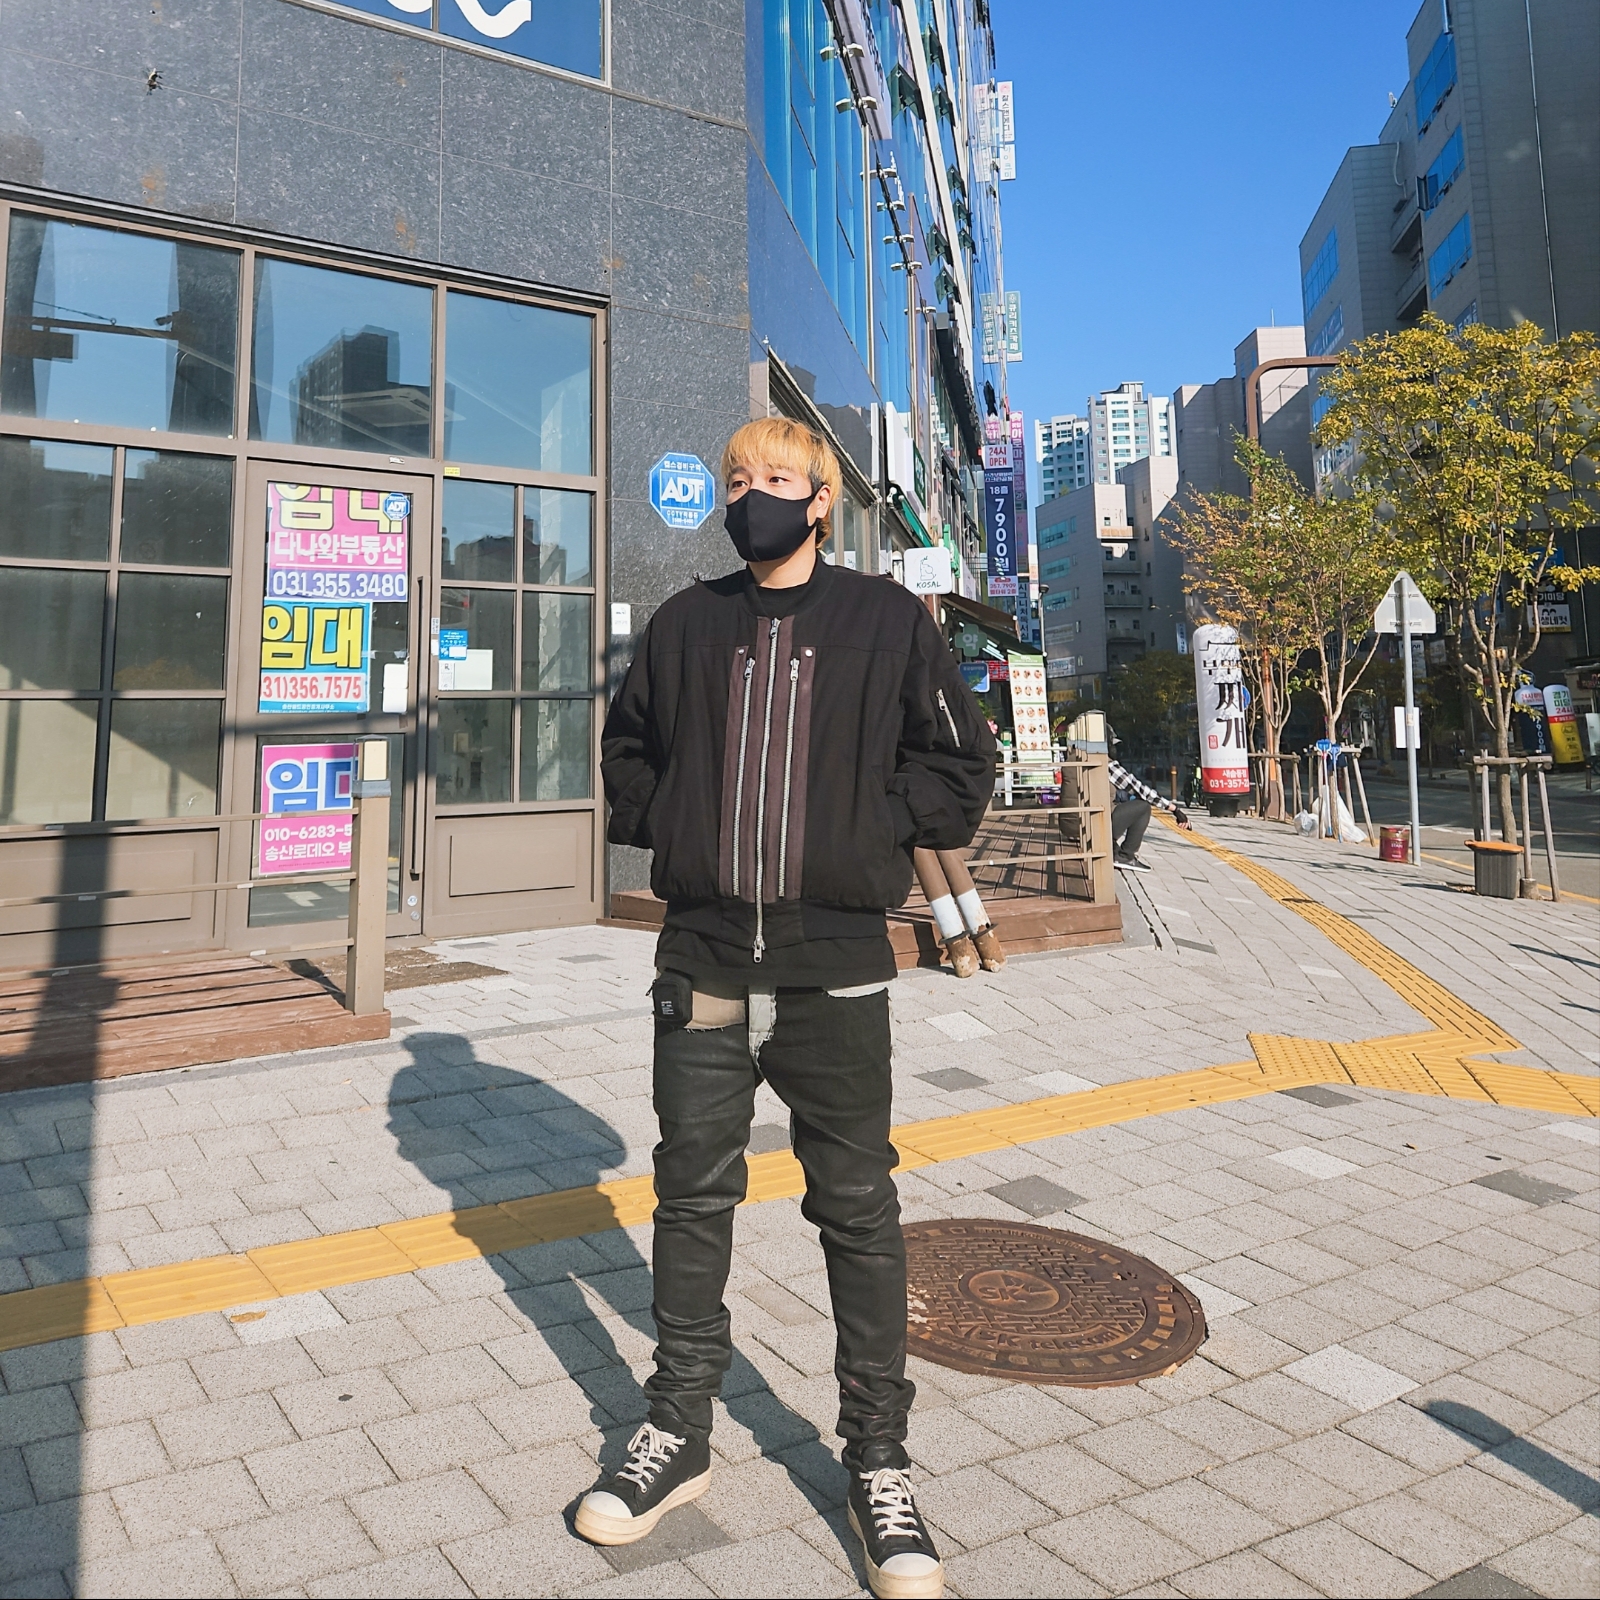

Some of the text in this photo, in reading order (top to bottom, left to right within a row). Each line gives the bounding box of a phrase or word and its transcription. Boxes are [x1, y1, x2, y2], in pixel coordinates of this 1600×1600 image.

[989, 447, 1007, 456] 24시
[989, 457, 1007, 466] OPEN
[661, 476, 705, 505] ADT
[387, 500, 407, 514] ADT
[274, 531, 404, 566] 다나와부동산
[272, 571, 407, 598] 031.355.3480
[916, 581, 942, 589] KOSAL
[1531, 592, 1565, 601] 기미당
[261, 604, 365, 670] 임대
[962, 633, 979, 650] 약
[1202, 659, 1241, 676] 부뚜
[260, 676, 362, 699] 31)356.7575
[264, 824, 352, 842] 010-6283-5
[264, 842, 335, 862] 송산로데오
[979, 1286, 1027, 1303] SK
[978, 1326, 1021, 1348] SK
[1030, 1331, 1120, 1351] telecom
